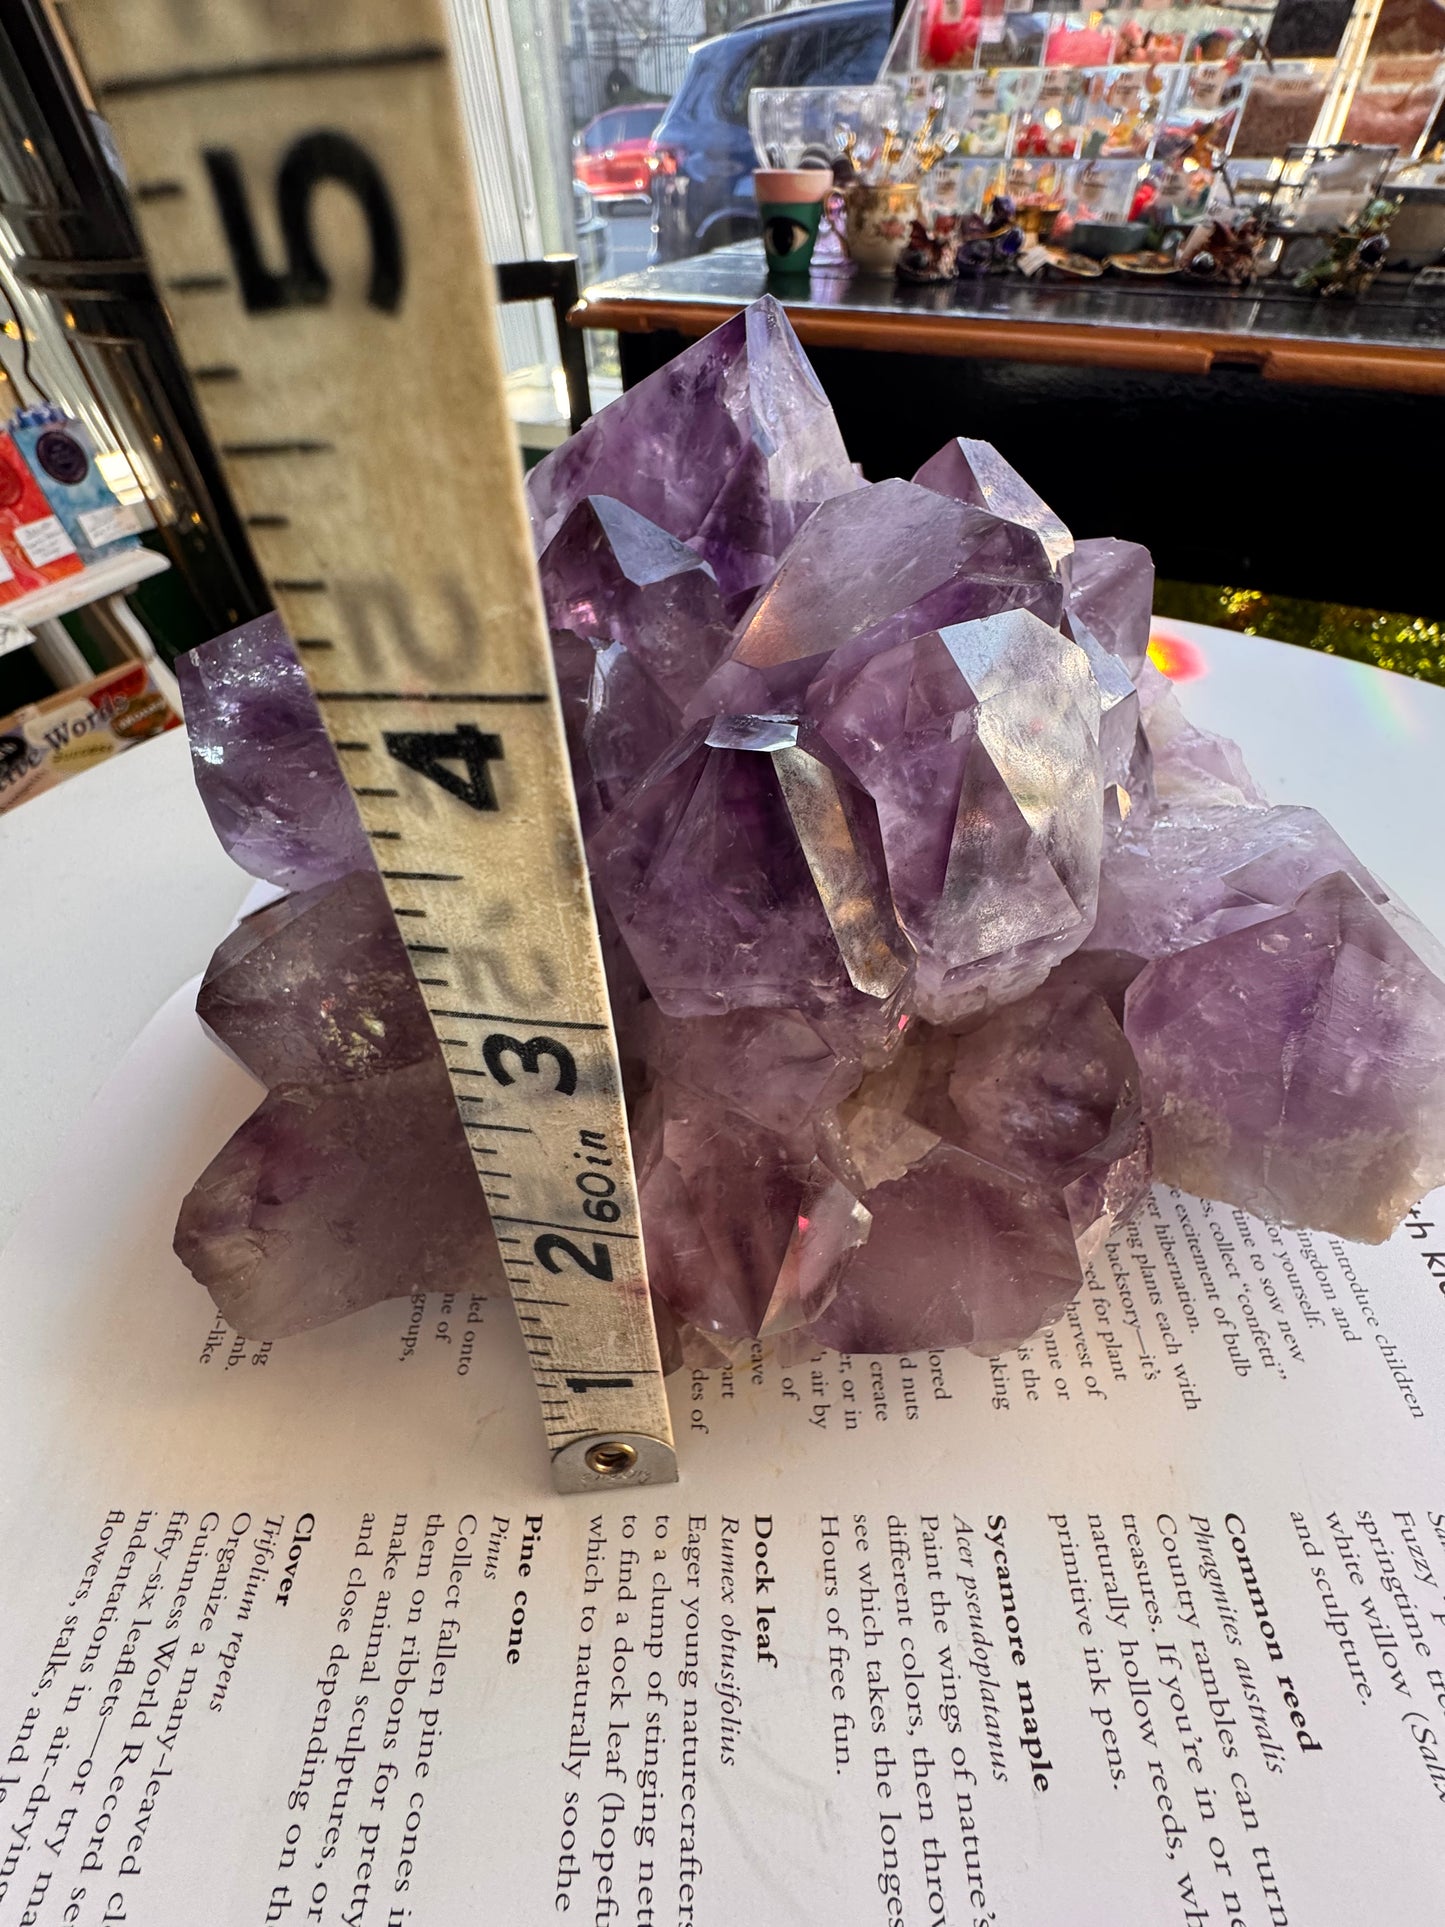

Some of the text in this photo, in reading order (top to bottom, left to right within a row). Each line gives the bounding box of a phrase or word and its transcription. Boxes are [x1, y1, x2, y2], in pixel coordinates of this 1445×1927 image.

[200, 131, 406, 316] 5
[42, 695, 129, 750] Words
[384, 722, 504, 812] 4
[482, 1032, 578, 1097] 3
[532, 1232, 614, 1282] 2
[1154, 1224, 1200, 1334] hibernation.
[1174, 1203, 1252, 1377] excitement of bulb
[1209, 1221, 1241, 1279] collect
[1231, 1209, 1305, 1363] time to sow new
[1272, 1251, 1326, 1329] yourself.
[1297, 1232, 1363, 1342] ingdom and
[399, 1292, 427, 1362] groups,
[435, 1321, 452, 1345] of
[457, 1330, 475, 1376] onto
[1062, 1301, 1108, 1401] harvest of
[1092, 1298, 1127, 1381] for plant
[1130, 1253, 1202, 1411] plants each with
[1329, 1240, 1424, 1419] introduce children
[565, 1376, 633, 1394] 1
[781, 1377, 801, 1402] of
[808, 1370, 832, 1429] air by
[841, 1379, 862, 1430] or in
[869, 1361, 888, 1422] create
[901, 1377, 919, 1420] nuts
[928, 1349, 952, 1400] lored
[1021, 1368, 1041, 1401] the
[1054, 1377, 1070, 1401] or
[690, 1409, 710, 1435] of
[275, 1512, 316, 1607] Clover
[483, 1514, 510, 1580] Pinus
[621, 1514, 638, 1539] to
[681, 1514, 707, 1588] Eager
[853, 1514, 869, 1552] see
[886, 1515, 913, 1626] different
[920, 1515, 943, 1580] Paint
[1391, 1511, 1439, 1588] Fuzzy
[79, 1510, 159, 1673] indentations
[199, 1512, 252, 1632] Organize
[209, 1514, 285, 1713] Trifolium repens
[506, 1513, 544, 1665] Pine cone
[617, 1549, 640, 1602] find
[754, 1514, 778, 1669] Dock leaf
[858, 1561, 885, 1649] which
[930, 1590, 953, 1634] the
[1289, 1511, 1372, 1706] and sculpture.
[1325, 1511, 1364, 1585] white
[1360, 1596, 1412, 1698] willow
[1354, 1510, 1431, 1657] springtime
[7, 1509, 126, 1765] flowers, stalks, and
[190, 1642, 206, 1657] a
[615, 1612, 630, 1626] a
[677, 1596, 700, 1689] young
[714, 1515, 743, 1766] Rumex obtusifolius
[820, 1515, 856, 1775] Hours of free fun.
[953, 1513, 1008, 1783] Acer pseudoplatanus
[983, 1515, 1054, 1793] Sycamore maple
[1047, 1513, 1126, 1790] primitive ink pens.
[1188, 1513, 1286, 1774] Phragmites australis
[1224, 1513, 1323, 1753] Common reed
[62, 1684, 93, 1715] in
[79, 1511, 220, 1874] Guinness World Record
[278, 1512, 376, 1871] and close depending on
[306, 1513, 408, 1924] make animal sculptures, or
[394, 1514, 478, 1893] Collect fallen pine cones
[554, 1514, 608, 1912] which to naturally soothe
[609, 1637, 635, 1711] dock
[633, 1515, 673, 1848] to a clump of stinging
[866, 1660, 890, 1733] takes
[900, 1637, 926, 1736] colors,
[937, 1644, 962, 1734] wings
[1087, 1513, 1188, 1860] naturally hollow reeds,
[1121, 1513, 1163, 1633] treasures.
[1155, 1643, 1183, 1671] If
[1193, 1786, 1217, 1822] in
[1208, 1836, 1232, 1877] or
[340, 1513, 446, 1927] them on ribbons for pretty
[605, 1721, 630, 1784] leaf
[1156, 1513, 1289, 1927] Country rambles can turn
[873, 1746, 897, 1799] the
[912, 1746, 936, 1823] then
[950, 1746, 978, 1787] of
[44, 1807, 79, 1858] try
